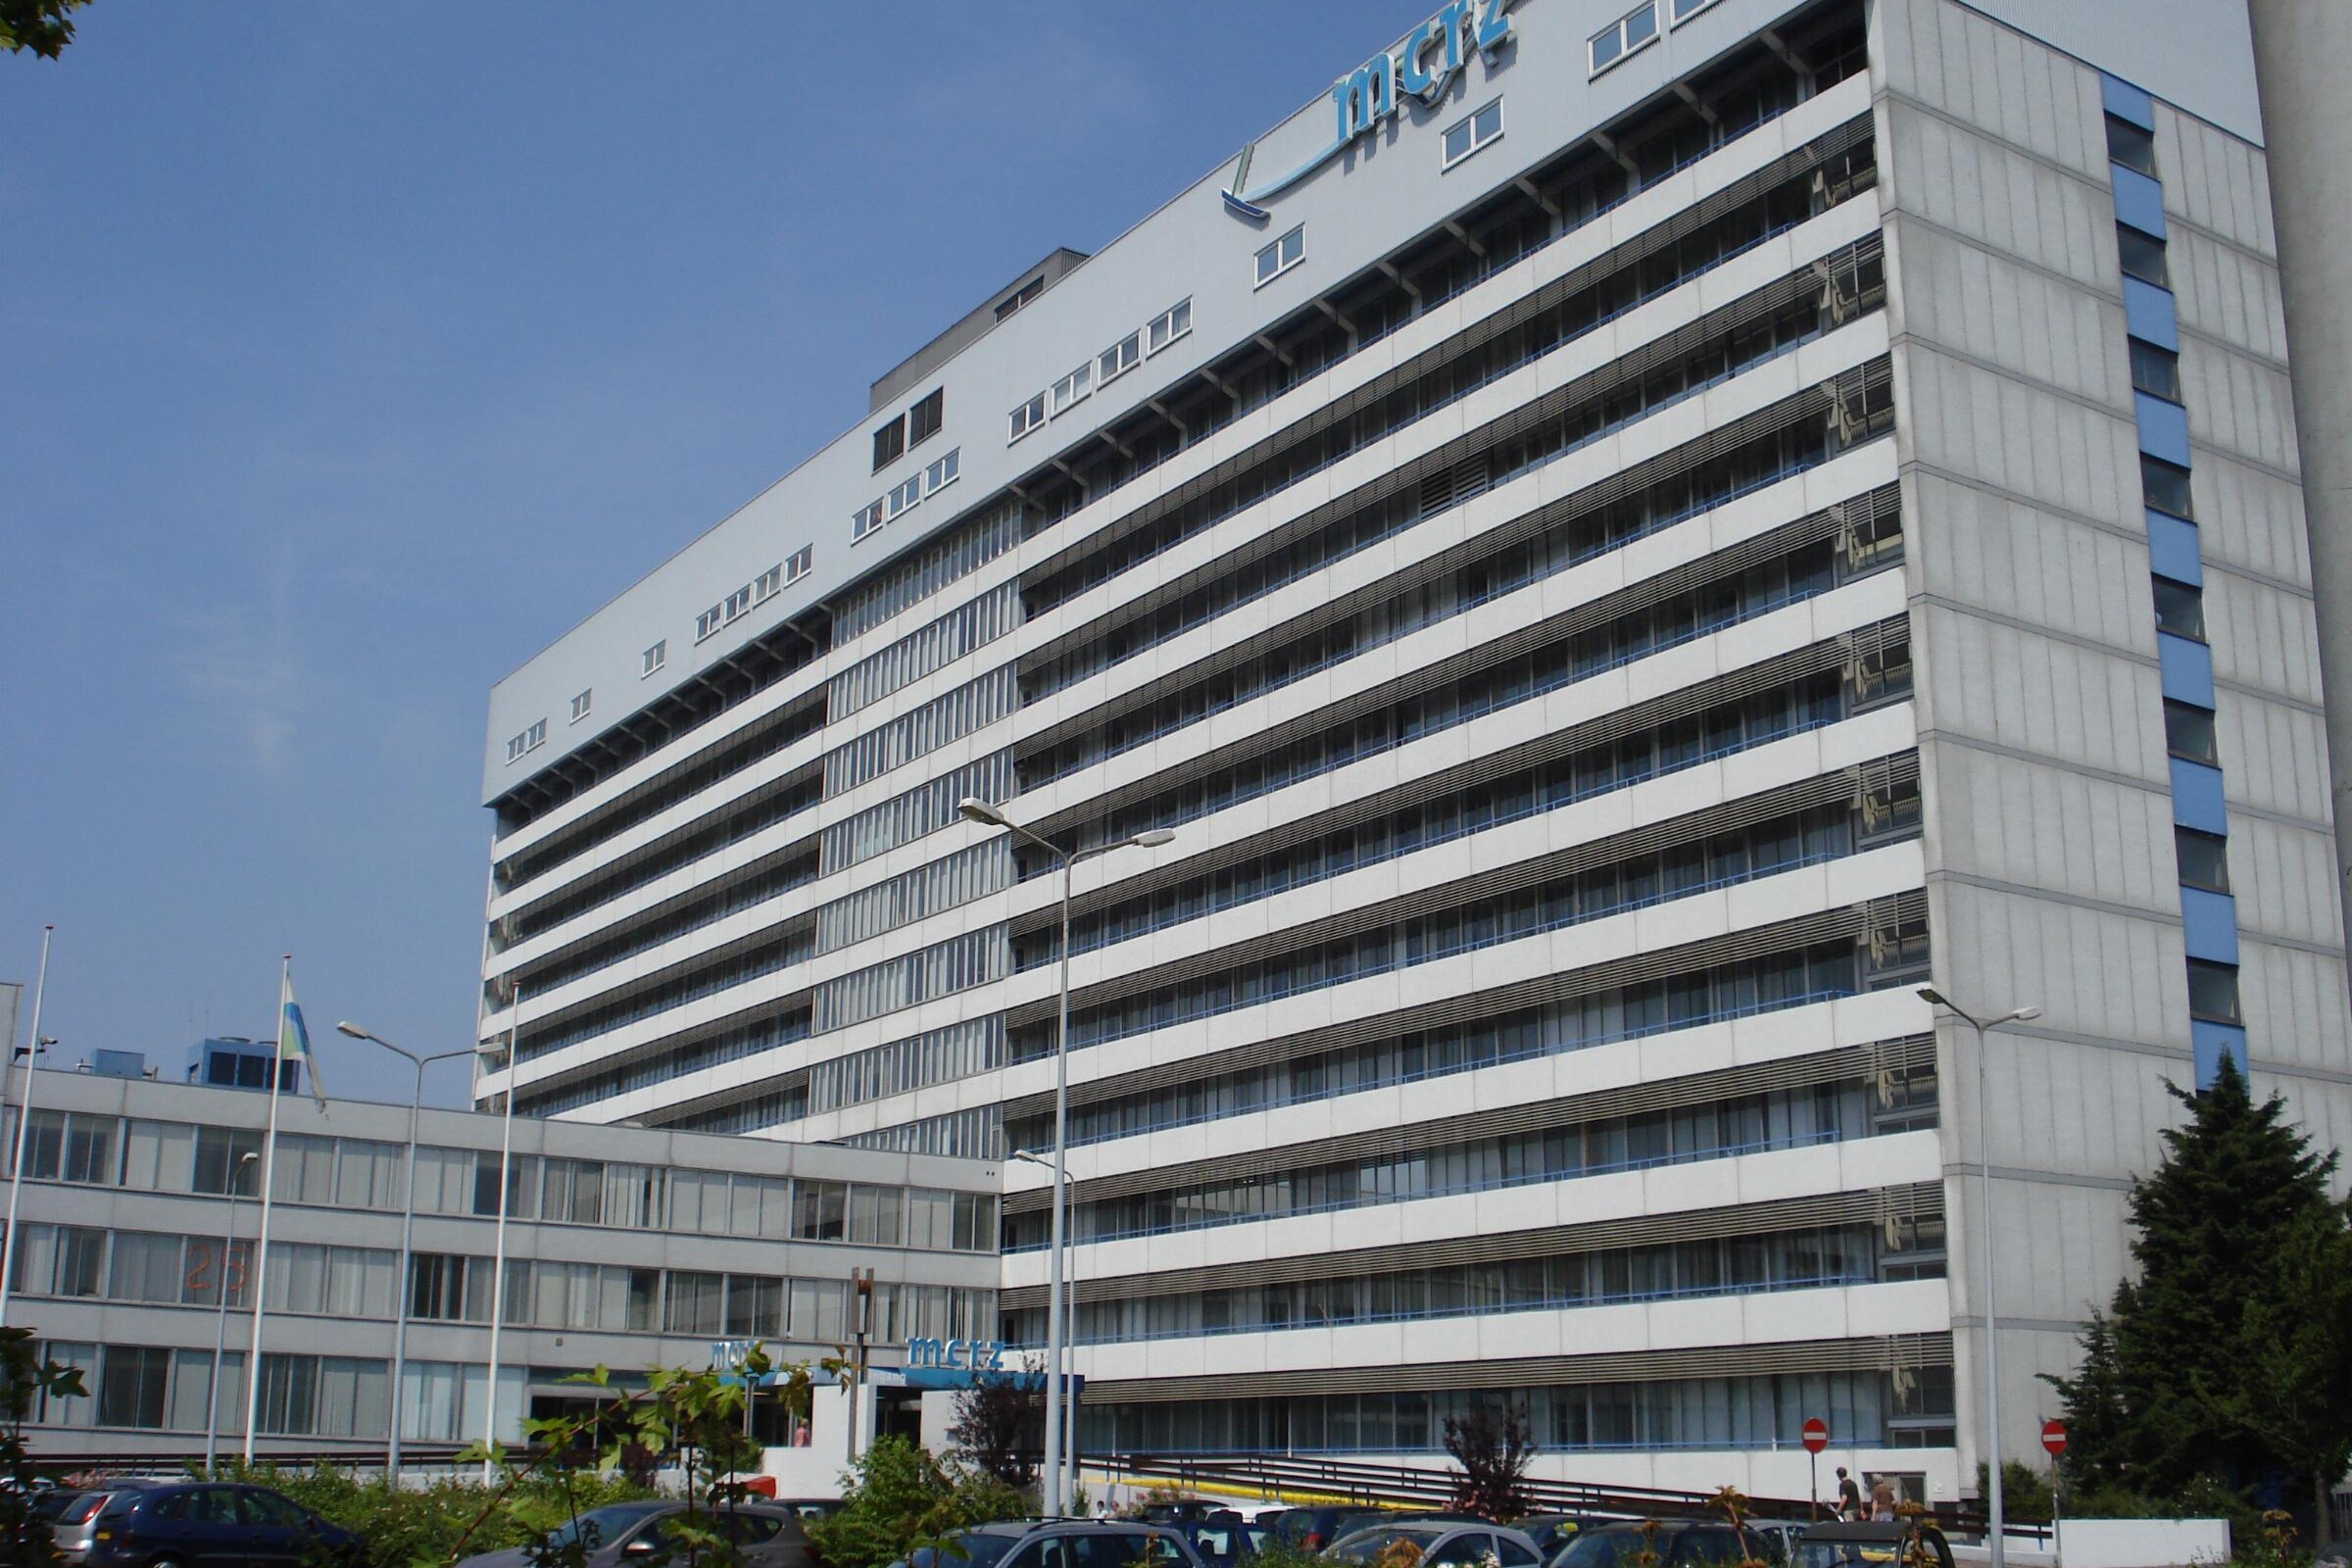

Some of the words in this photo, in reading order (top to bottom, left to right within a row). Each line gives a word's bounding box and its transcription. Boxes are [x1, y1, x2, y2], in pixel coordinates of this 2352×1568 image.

[1333, 0, 1513, 144] mcrz
[711, 1340, 758, 1371] mcr
[906, 1337, 1004, 1368] mcrz
